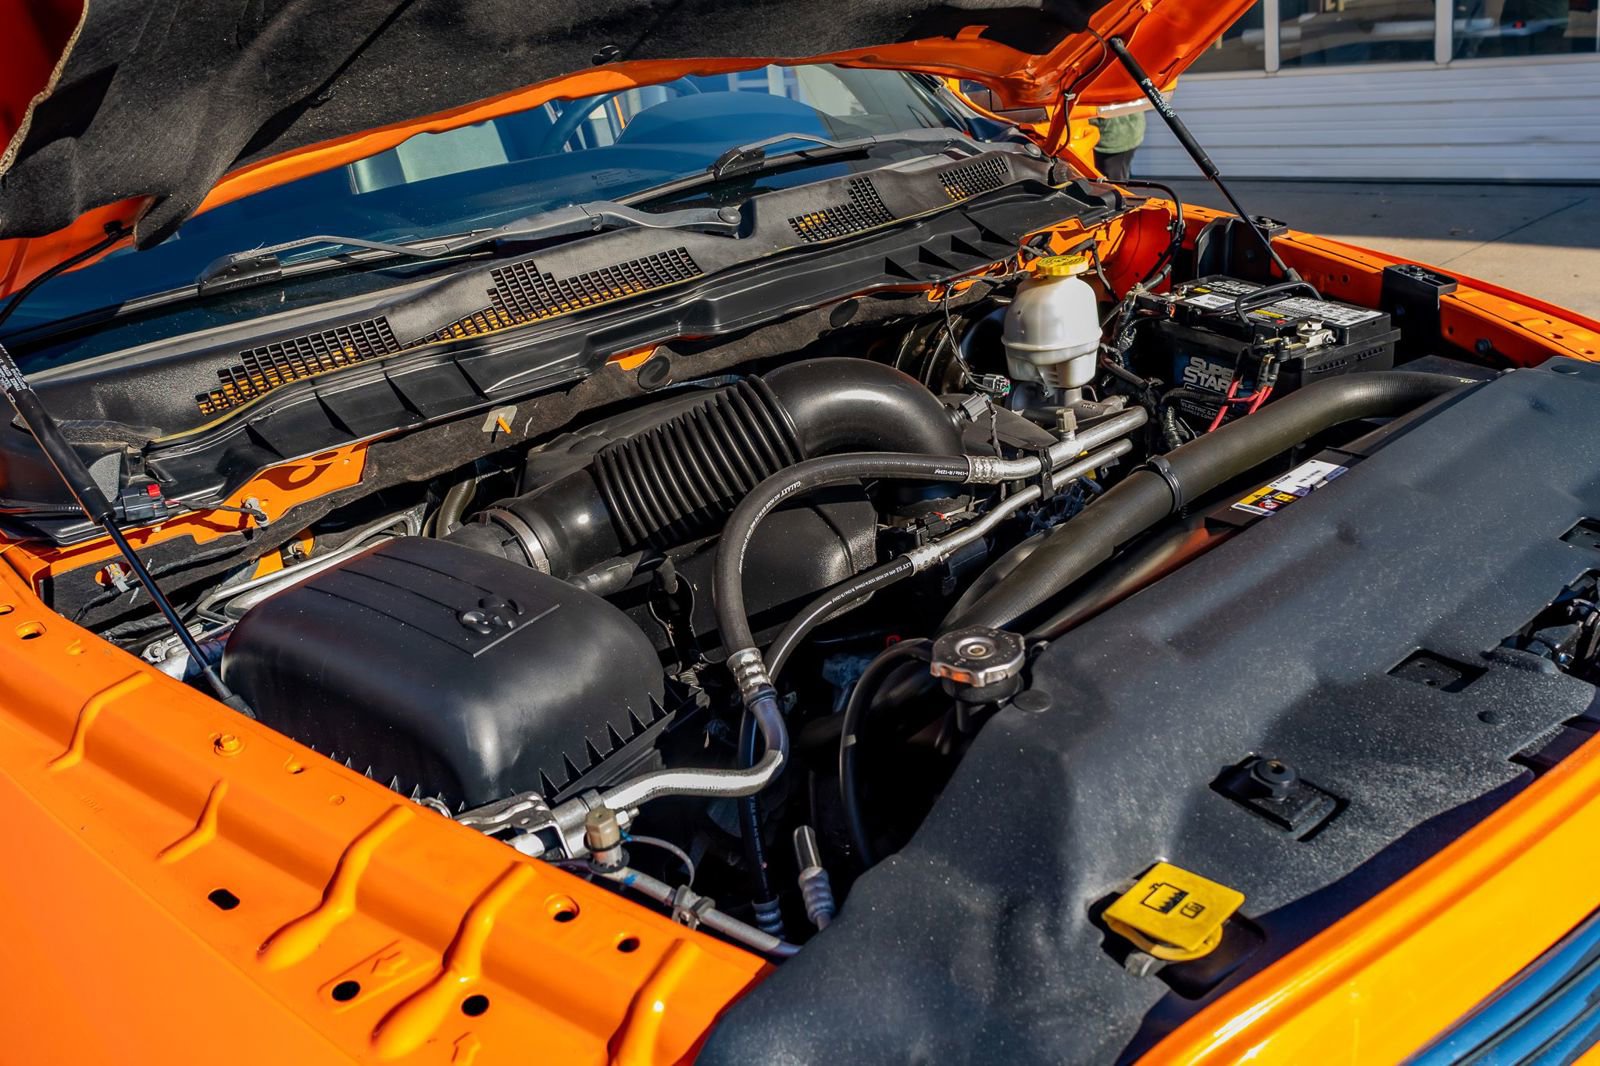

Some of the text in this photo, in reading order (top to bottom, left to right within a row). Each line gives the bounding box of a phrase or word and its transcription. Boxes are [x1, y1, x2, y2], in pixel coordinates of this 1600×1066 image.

[1183, 366, 1243, 395] STAR
[1190, 356, 1235, 382] SUPE
[781, 480, 801, 497] GALAXY
